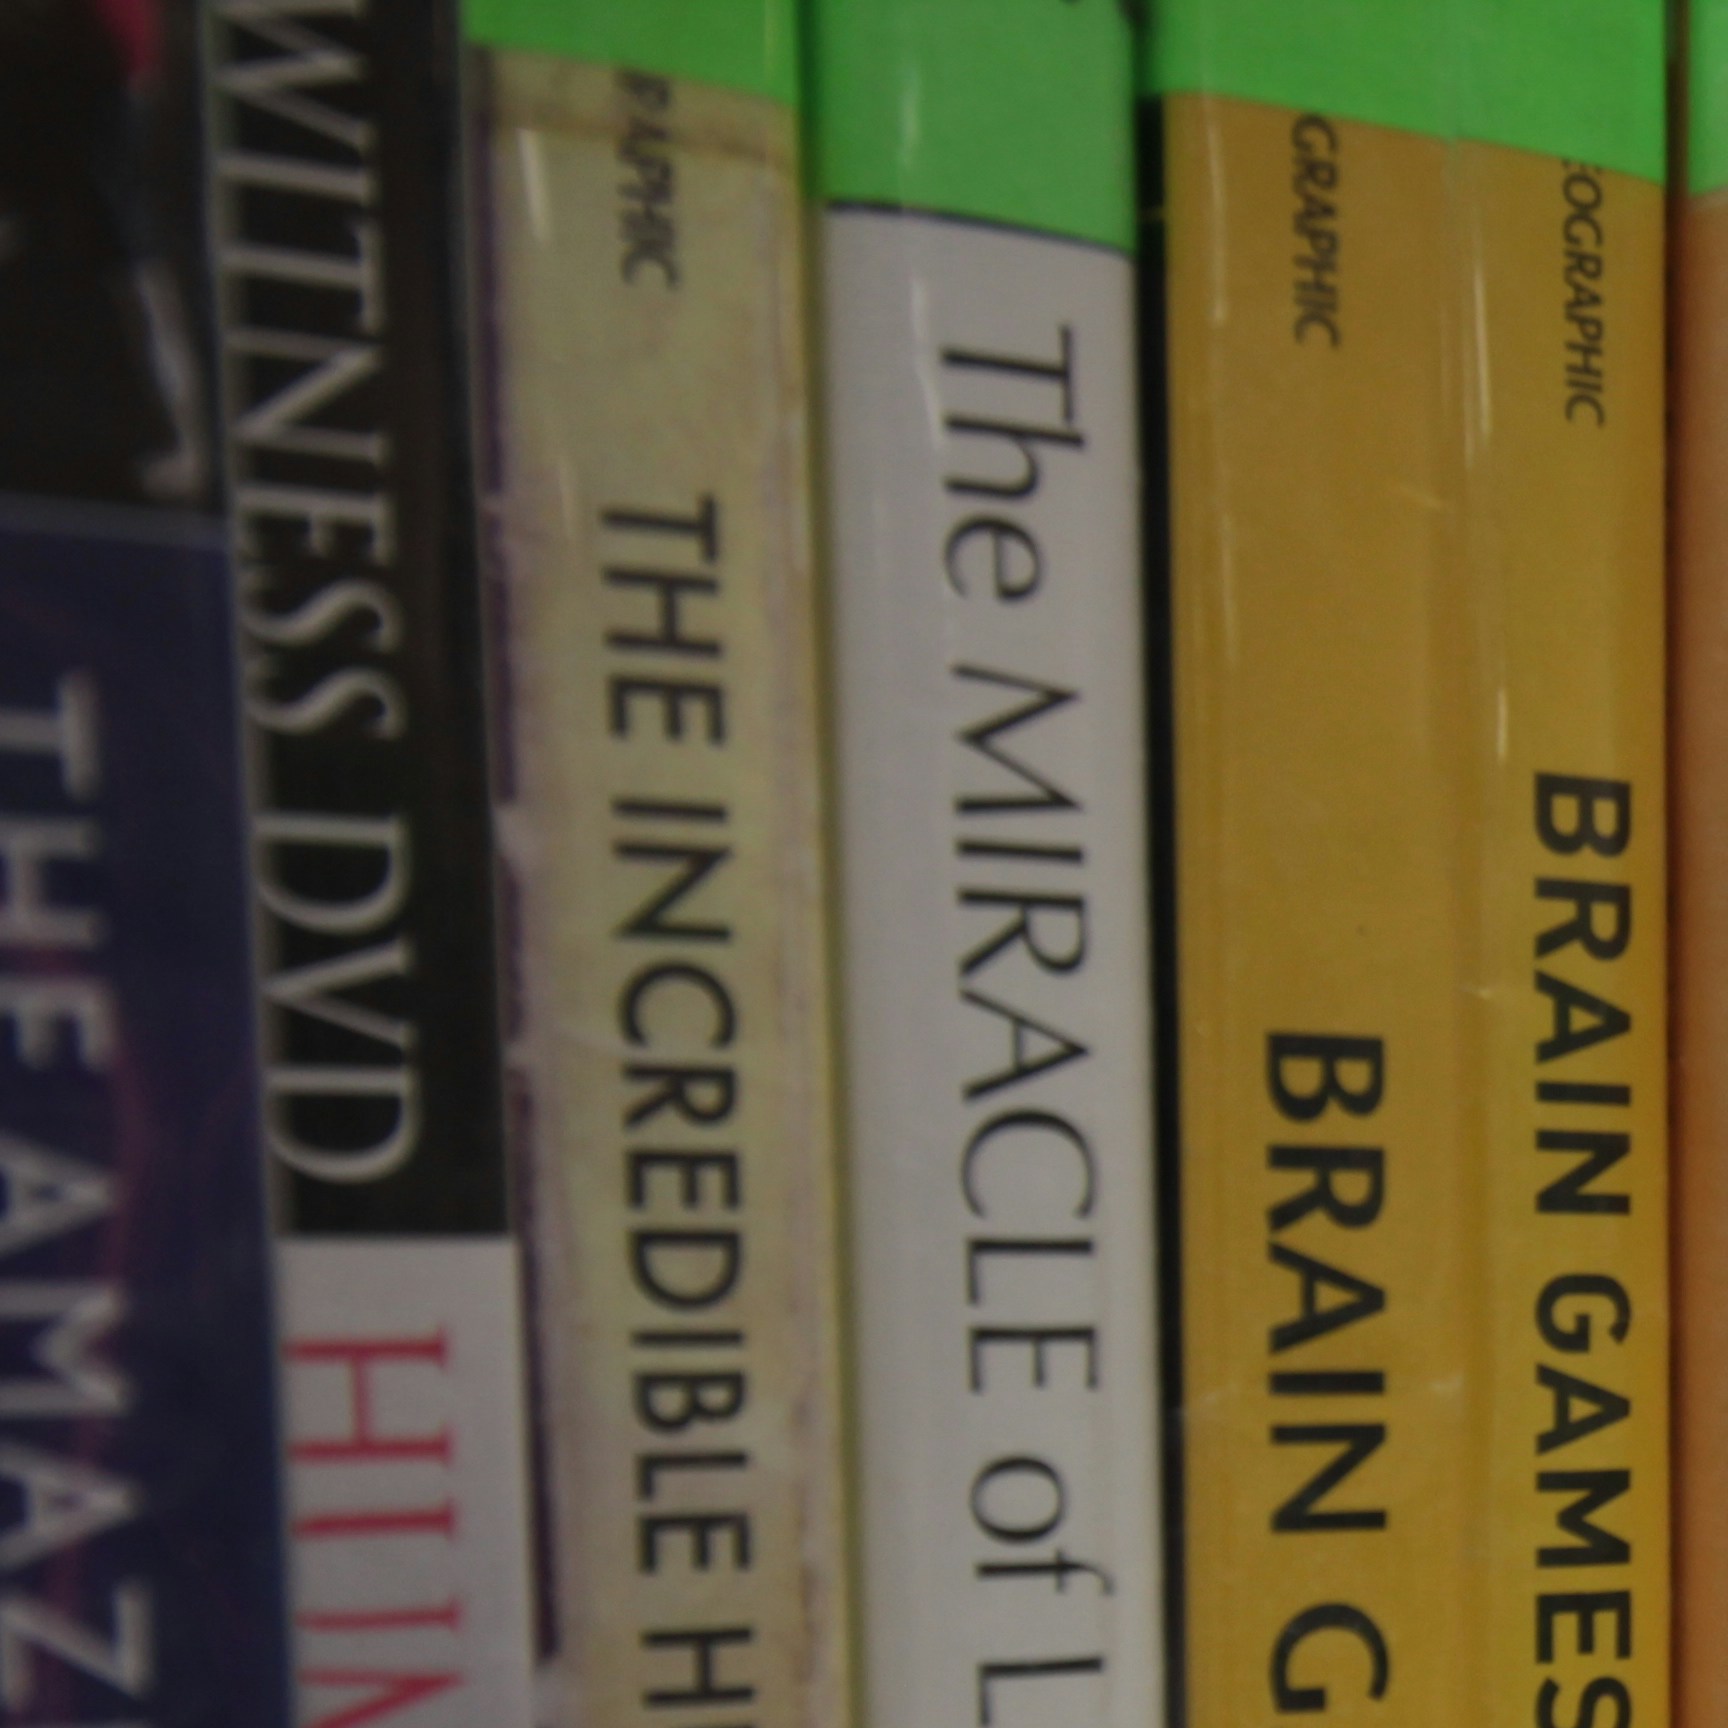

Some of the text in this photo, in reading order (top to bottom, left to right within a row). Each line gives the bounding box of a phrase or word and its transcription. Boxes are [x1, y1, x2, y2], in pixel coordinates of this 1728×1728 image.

[600, 494, 727, 748] THE
[939, 323, 1085, 603] The
[248, 811, 420, 1182] DVD
[609, 800, 754, 1573] INCREDIBLE
[950, 661, 1101, 1394] MIRACLE
[1532, 771, 1633, 1216] BRAIN
[1265, 1029, 1388, 1535] BRAIN
[968, 1454, 1115, 1596] of
